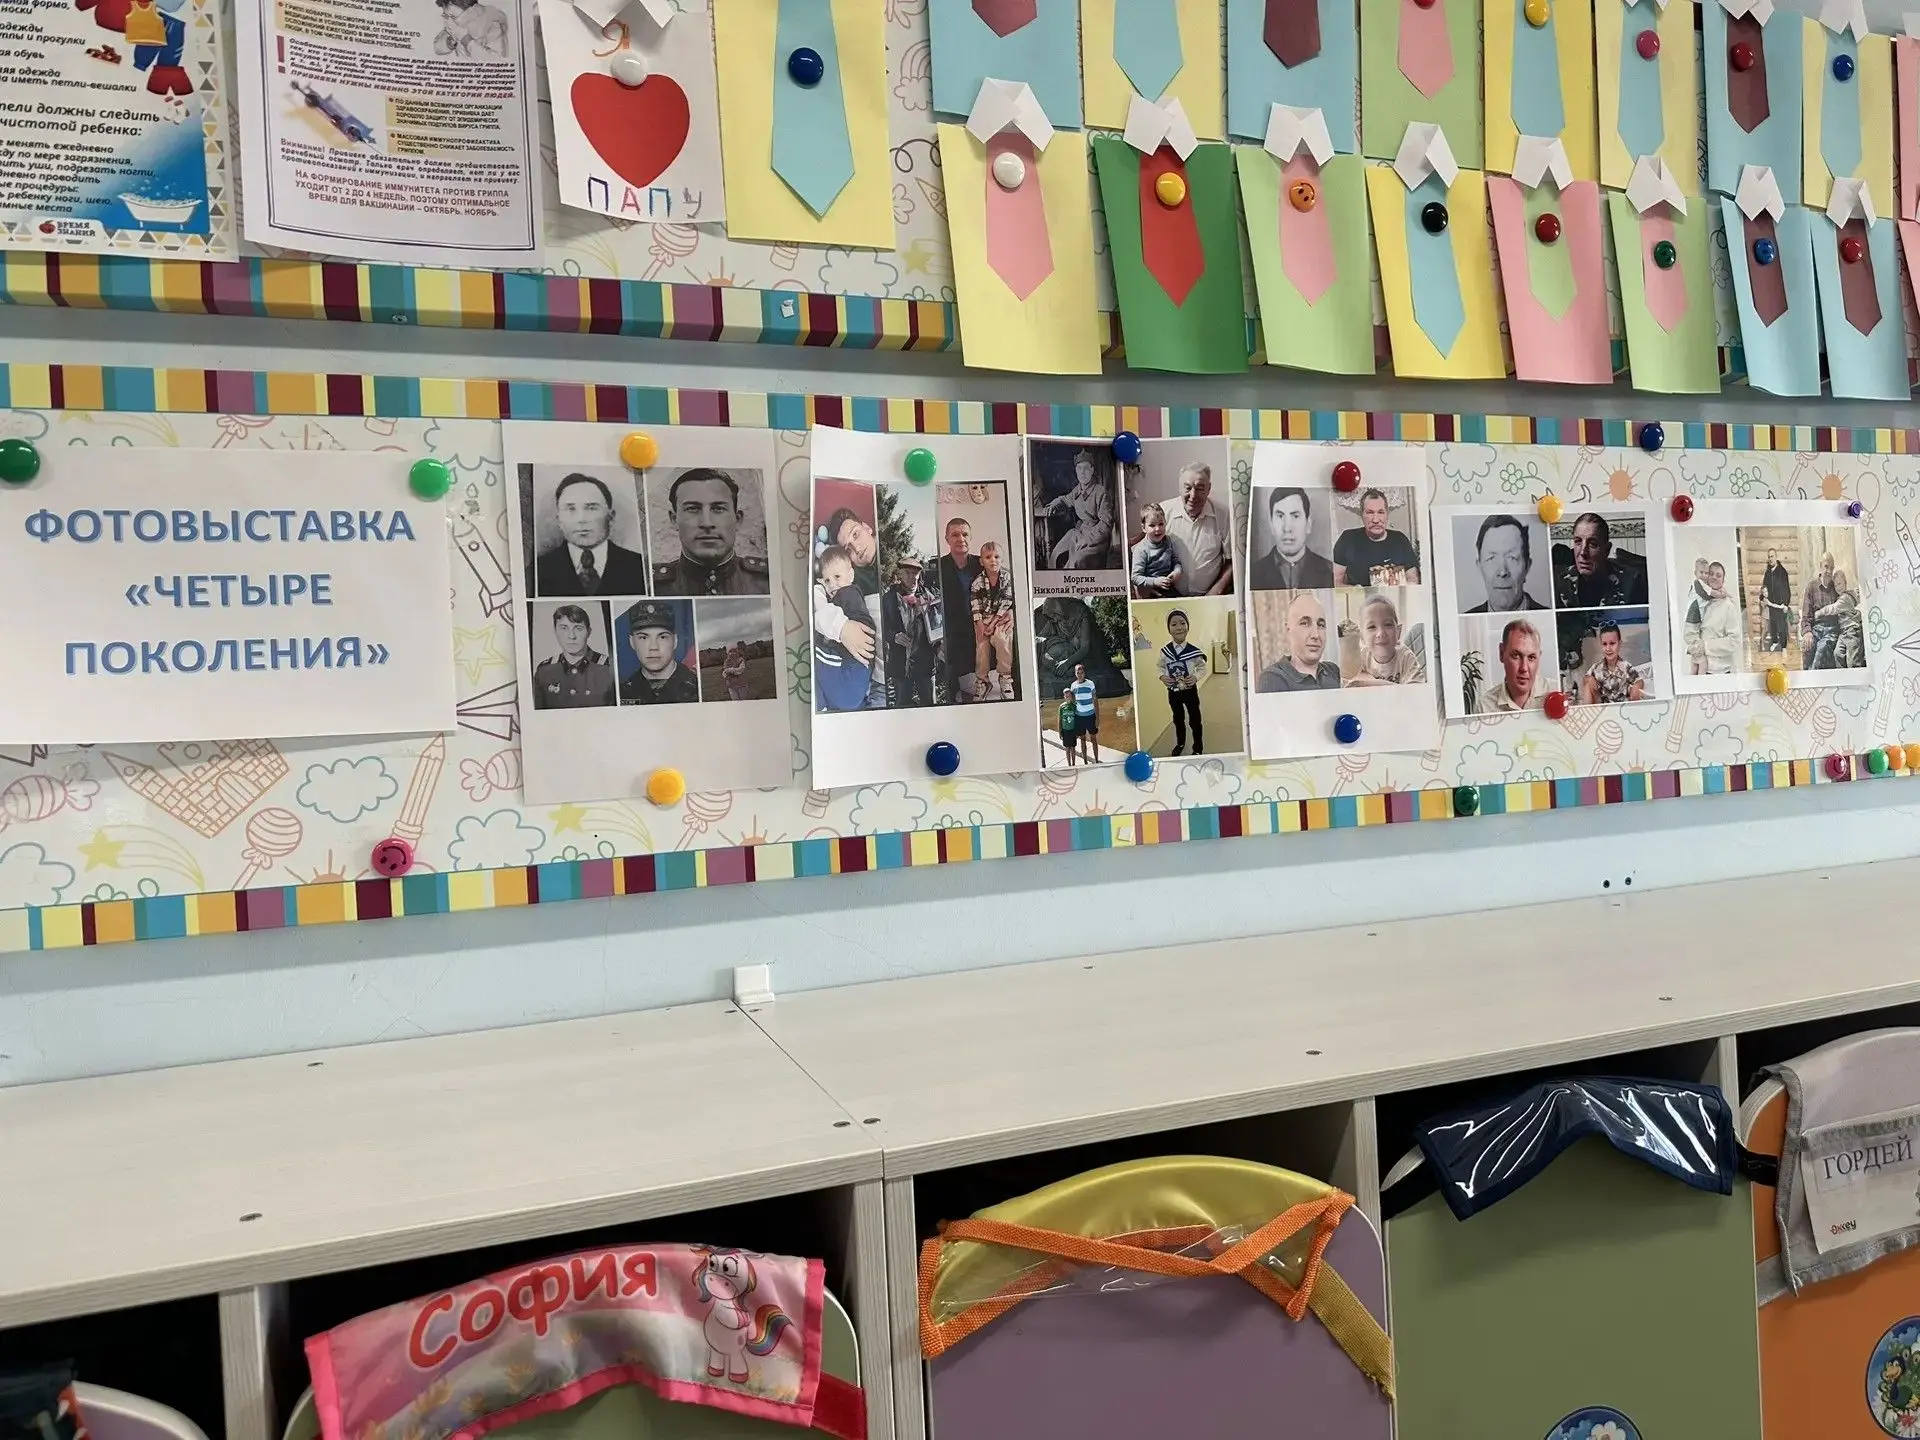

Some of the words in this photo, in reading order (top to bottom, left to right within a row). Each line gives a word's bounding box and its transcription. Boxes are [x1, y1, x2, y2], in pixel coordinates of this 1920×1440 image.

[36, 35, 86, 45] прогулки
[14, 50, 45, 60] обувь
[19, 66, 61, 78] одежда
[11, 76, 48, 85] иметь
[50, 80, 137, 92] петли-вешалки
[37, 103, 96, 117] должны
[100, 109, 160, 122] следить
[0, 118, 78, 132] чистотой
[80, 122, 142, 136] ребенка:
[6, 140, 50, 148] менять
[54, 142, 114, 154] ежедневно
[34, 153, 60, 162] мере
[64, 154, 133, 166] загрязнения,
[28, 162, 54, 171] уши,
[56, 164, 116, 174] подрезать
[120, 169, 156, 178] ногти,
[39, 174, 101, 184] проводить
[296, 170, 309, 179] НА
[311, 173, 383, 188] ФОРМИРОВАНИЕ
[384, 182, 440, 194] ИММУНИТЕТА
[443, 188, 476, 196] ПРОТИВ
[478, 190, 510, 198] ГРИППА
[15, 182, 79, 193] процедуры:
[296, 180, 330, 192] УХОДИТ
[332, 186, 343, 194] ОТ
[352, 188, 364, 197] ДО
[410, 194, 449, 204] ПОЭТОМУ
[451, 198, 510, 208] ОПТИМАЛЬНОЕ
[8, 191, 52, 202] ребенку
[55, 196, 82, 204] ноги,
[309, 192, 338, 203] ВРЕМЯ
[340, 197, 357, 206] ДЛЯ
[360, 200, 415, 212] ВАКЦИНАЦИИ
[36, 204, 73, 213] места
[24, 508, 416, 544] ФОТОВЫСТАВКА
[1064, 576, 1096, 584] Моргин
[126, 573, 333, 608] «ЧЕТЫРЕ
[1034, 586, 1070, 594] Николай
[1072, 586, 1126, 595] Герасимович
[64, 636, 392, 676] ПОКОЛЕНИЯ»
[1824, 1134, 1913, 1179] ГОРДЕЙ
[410, 1252, 657, 1368] София
